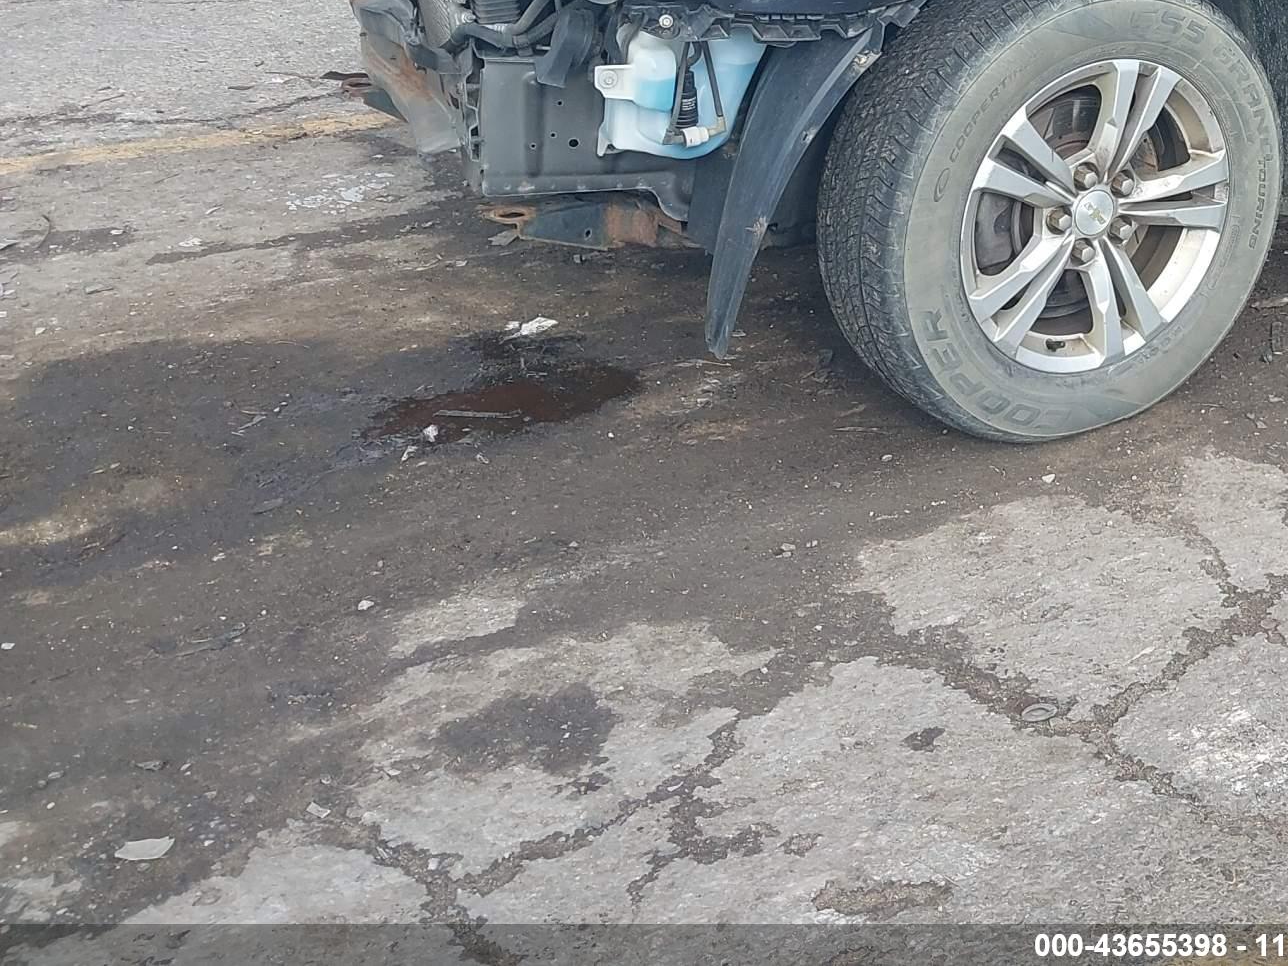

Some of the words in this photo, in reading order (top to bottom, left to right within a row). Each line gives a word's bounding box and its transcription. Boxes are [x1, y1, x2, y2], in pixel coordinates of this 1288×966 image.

[1212, 45, 1274, 162] GRAND
[1248, 155, 1268, 250] TOURING
[919, 308, 1072, 430] COOPER
